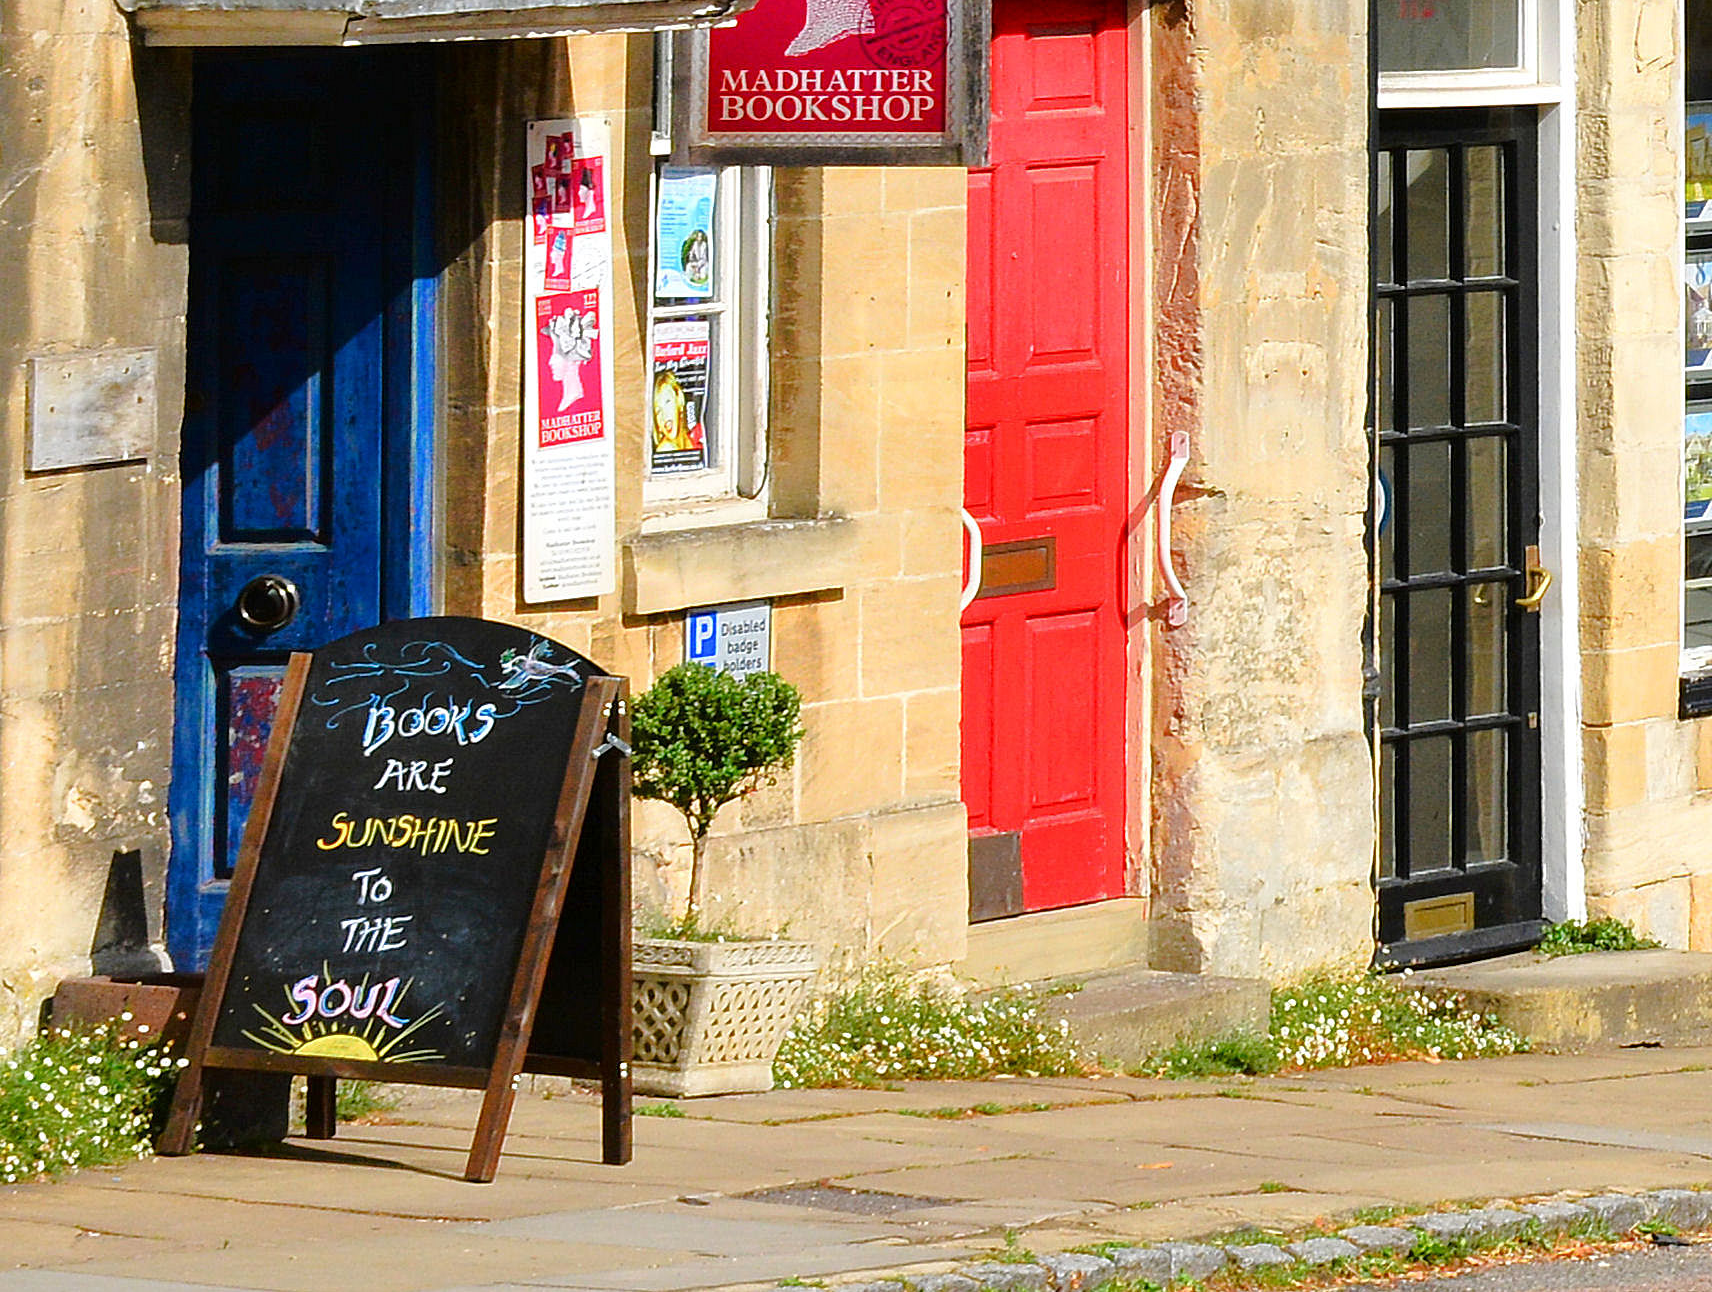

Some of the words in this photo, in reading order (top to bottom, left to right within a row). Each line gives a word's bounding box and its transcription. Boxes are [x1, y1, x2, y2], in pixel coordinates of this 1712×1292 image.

[720, 70, 934, 92] MADHATTER
[719, 95, 935, 121] BOOKSHOP
[541, 410, 600, 430] MADHATTER
[541, 422, 602, 443] BOOKSHOP
[696, 616, 713, 654] P
[721, 618, 766, 637] Disabled
[728, 640, 759, 654] badge
[363, 699, 497, 756] BOOKS
[374, 758, 454, 793] ARE
[317, 812, 498, 856] SUNSHINE
[341, 915, 413, 953] THE
[282, 974, 410, 1028] SOUL
